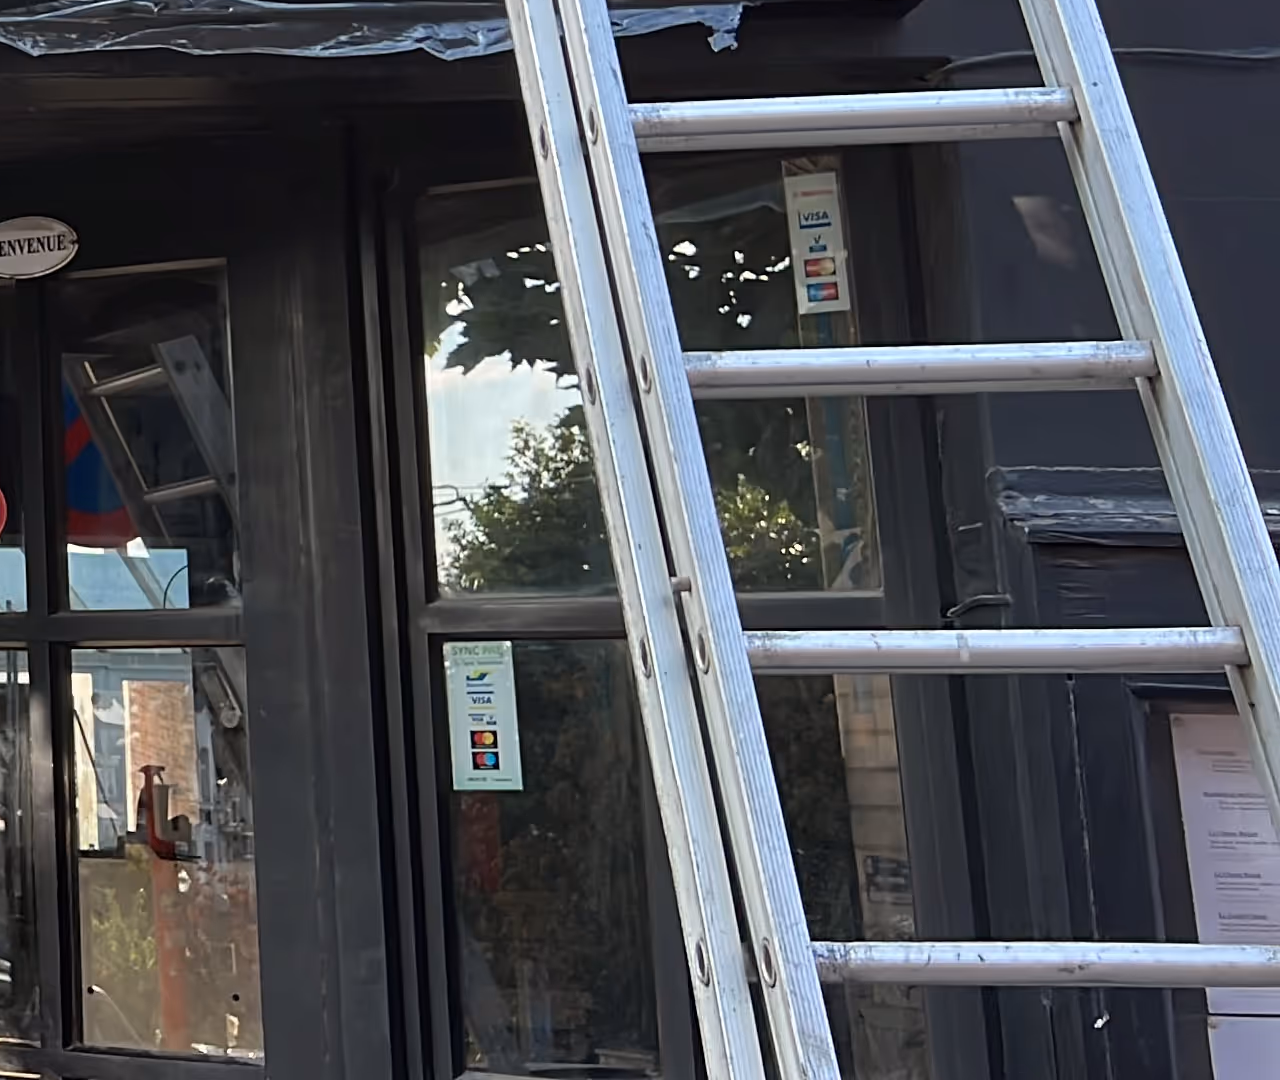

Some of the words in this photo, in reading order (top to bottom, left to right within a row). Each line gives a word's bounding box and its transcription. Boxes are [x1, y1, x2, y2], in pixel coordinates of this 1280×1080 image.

[802, 210, 830, 222] VISA
[452, 645, 479, 656] SYNC
[471, 696, 492, 705] VISA
